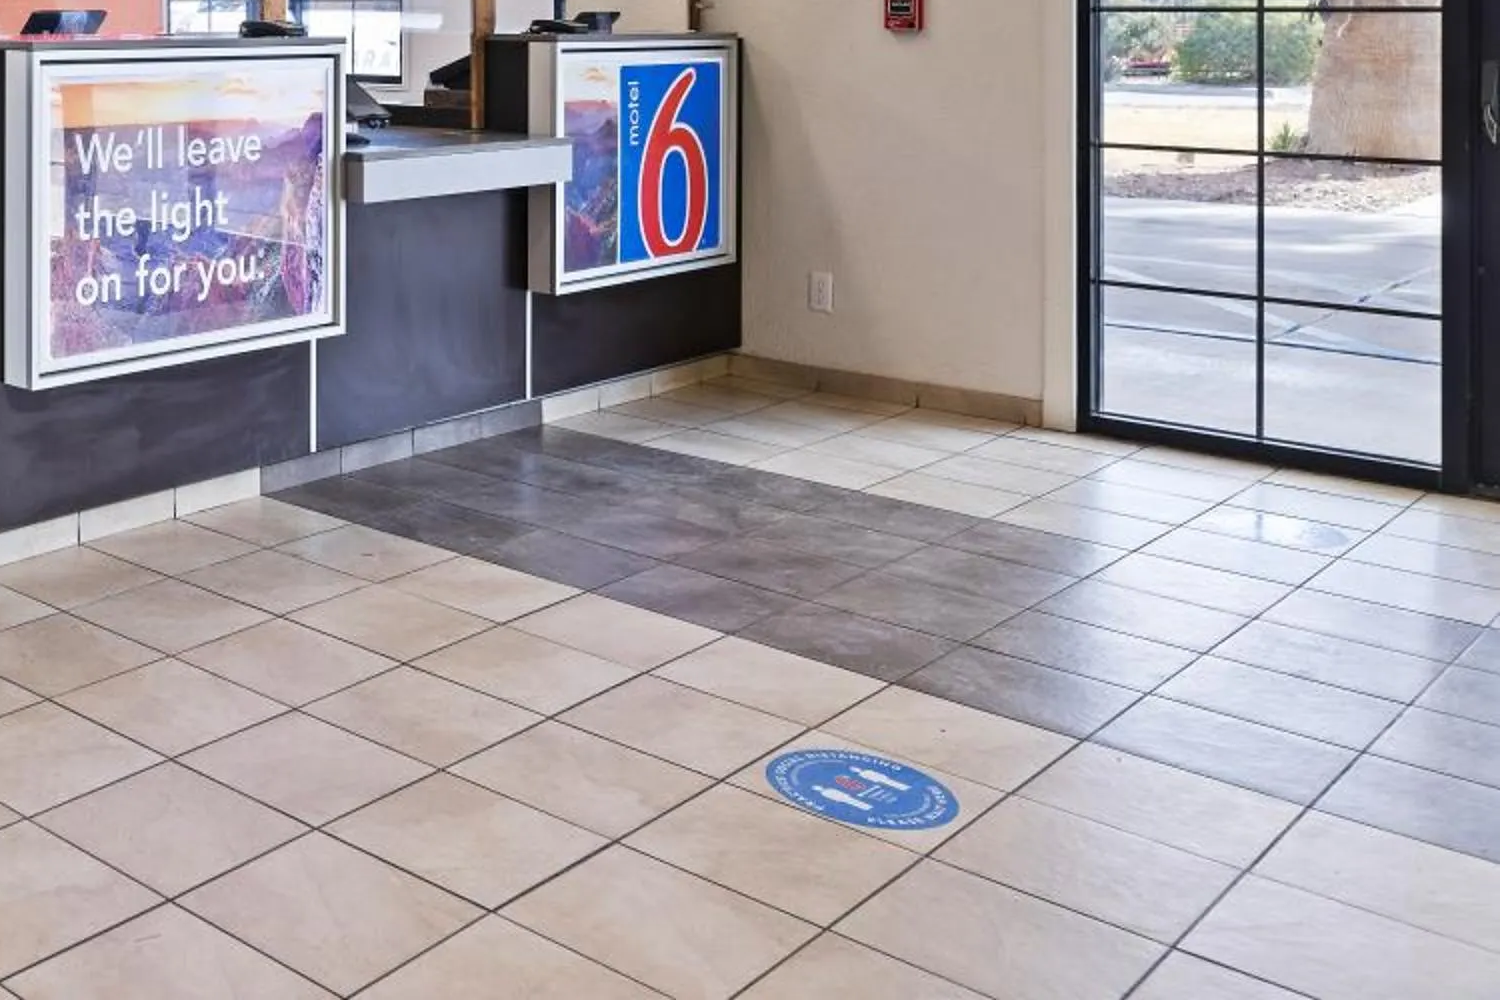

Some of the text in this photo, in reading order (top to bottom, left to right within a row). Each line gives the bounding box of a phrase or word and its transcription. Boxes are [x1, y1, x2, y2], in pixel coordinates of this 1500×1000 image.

[75, 123, 262, 175] We'll leave
[628, 67, 709, 261] motel 6
[75, 186, 229, 242] the light
[75, 273, 121, 305] on
[135, 254, 186, 297] for
